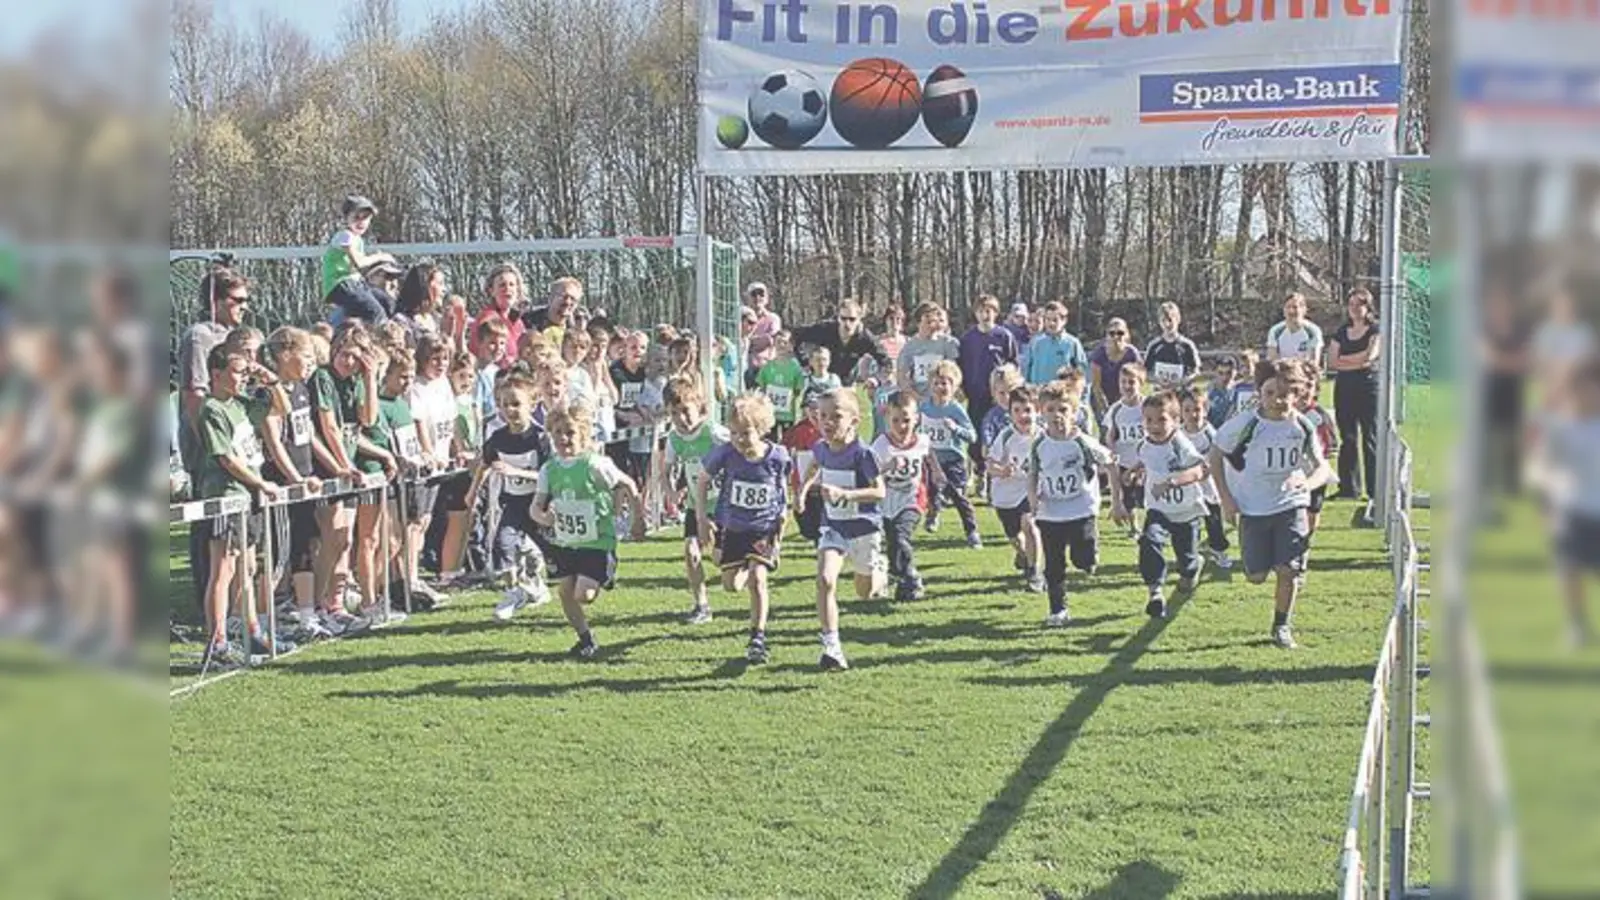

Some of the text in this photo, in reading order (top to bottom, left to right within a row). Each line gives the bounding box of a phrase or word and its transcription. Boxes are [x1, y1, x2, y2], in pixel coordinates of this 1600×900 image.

[718, 0, 808, 43] Fit
[835, 0, 898, 45] in
[927, 0, 1039, 45] die
[1172, 73, 1380, 108] Sparda-Bank
[1203, 114, 1387, 151] freundlich & fair
[1266, 446, 1299, 469] 110
[734, 485, 768, 507] 188
[1046, 474, 1079, 495] 142
